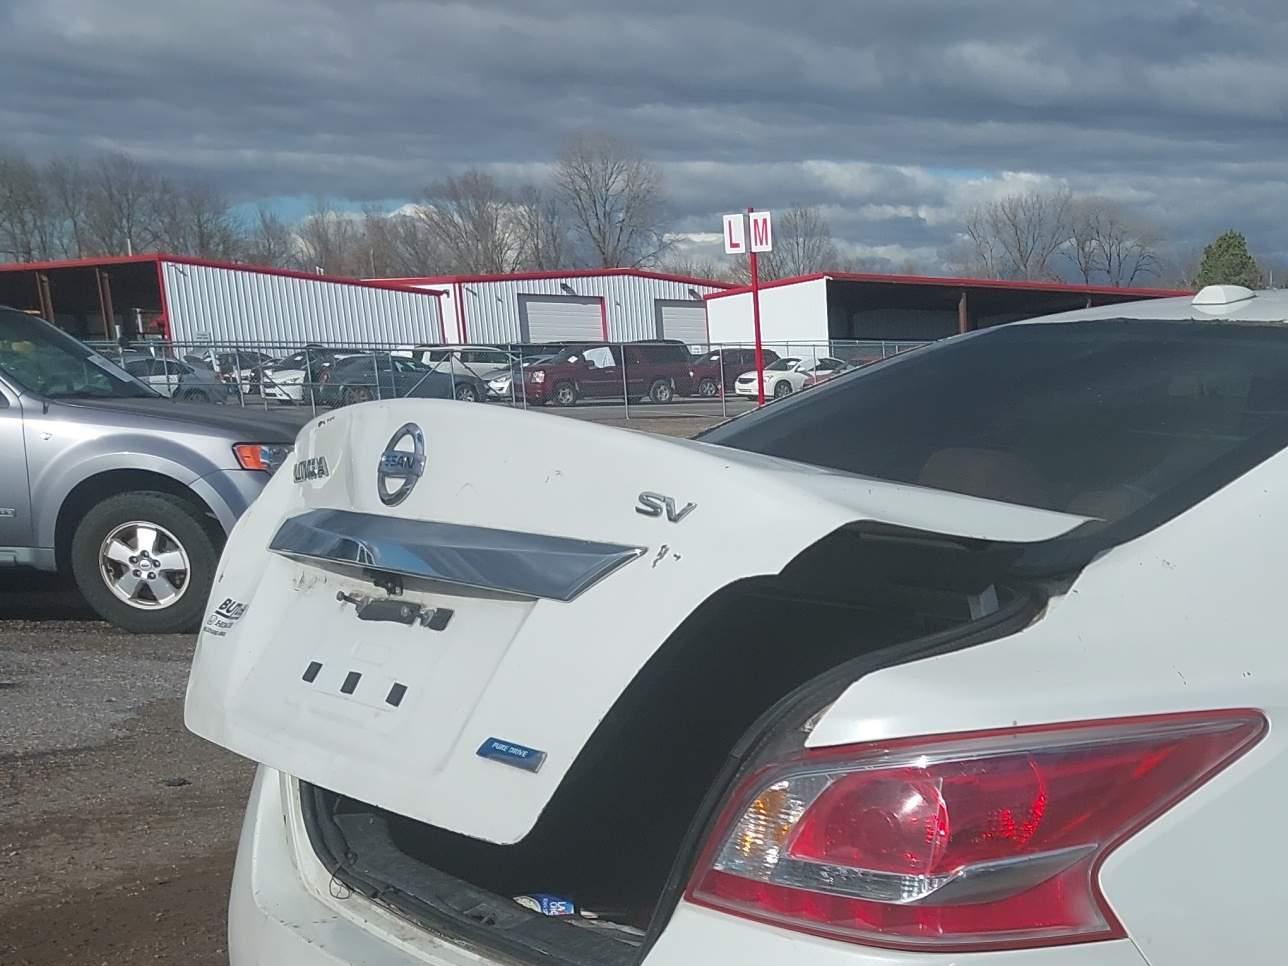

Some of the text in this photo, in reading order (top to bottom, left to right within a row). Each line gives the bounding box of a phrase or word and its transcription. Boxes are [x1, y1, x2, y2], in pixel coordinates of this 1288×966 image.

[728, 218, 769, 248] L M
[635, 491, 698, 523] SV
[491, 742, 529, 758] PURE DRIVE
